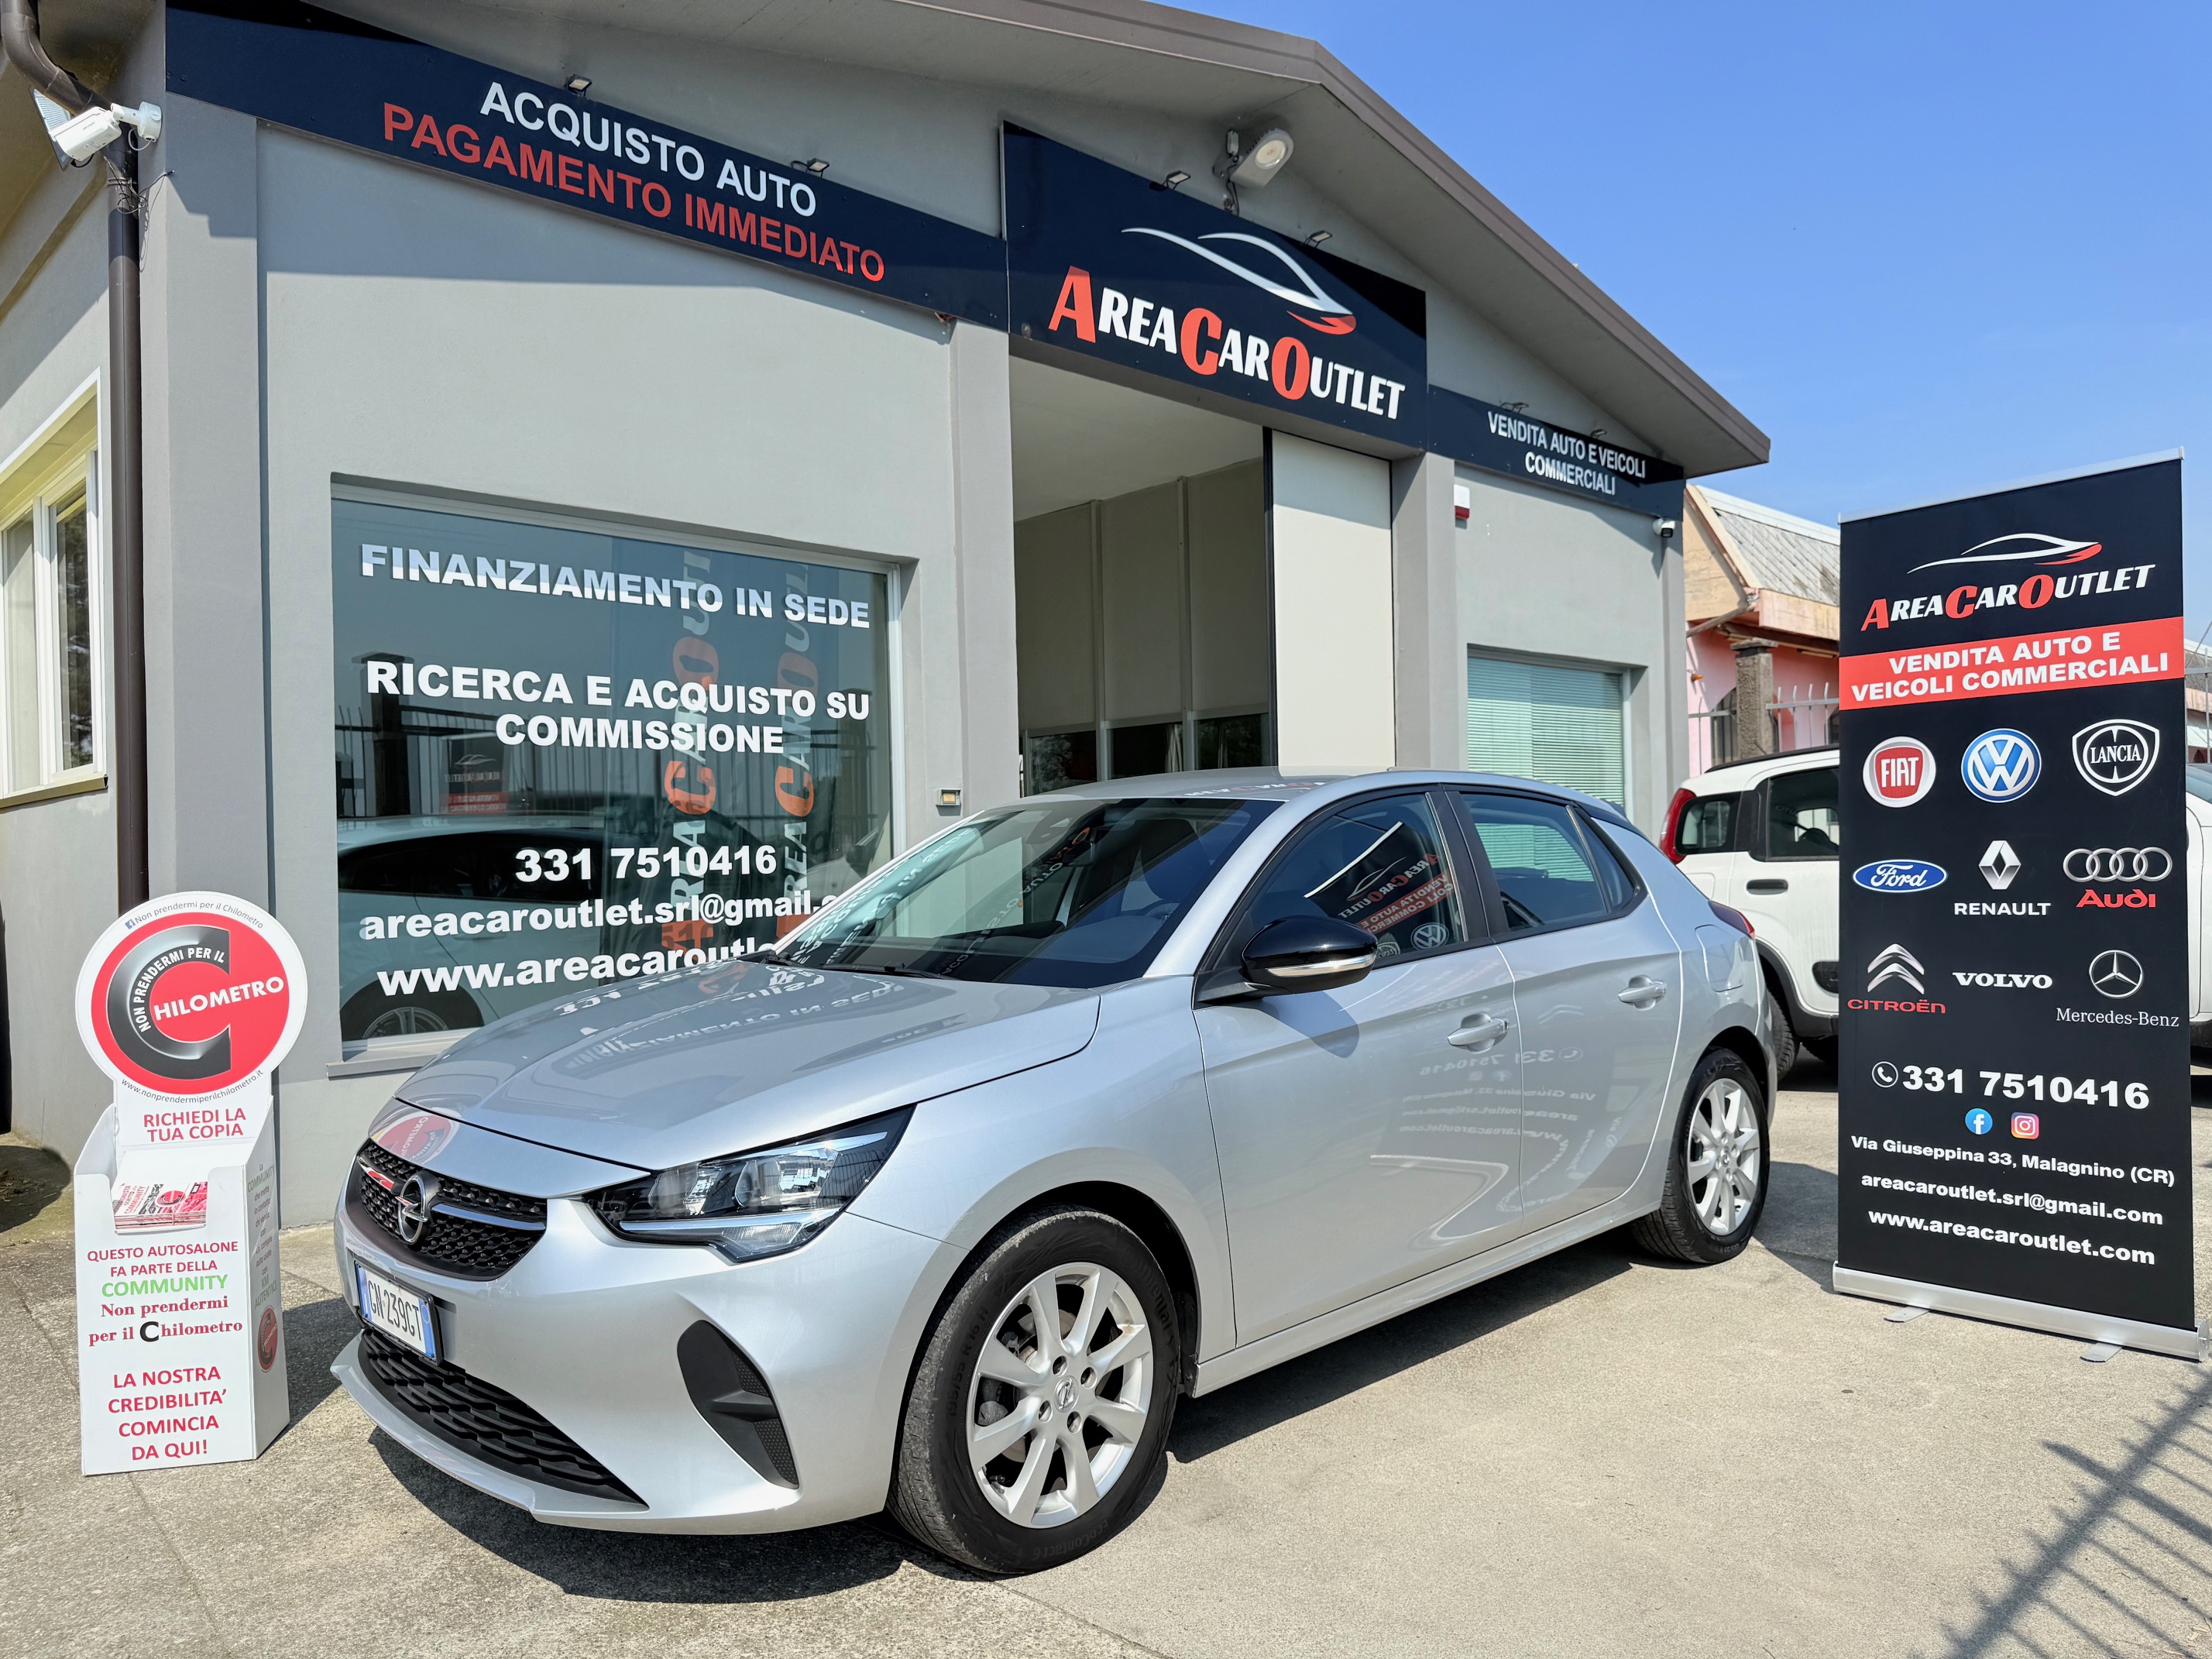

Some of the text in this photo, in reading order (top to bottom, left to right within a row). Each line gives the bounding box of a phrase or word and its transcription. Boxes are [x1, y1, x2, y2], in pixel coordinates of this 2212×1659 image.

[480, 82, 816, 217] ACQUISTO AUTO
[383, 102, 885, 282] PAGAMENTO IMMEDIATO
[1488, 411, 1646, 479] VENDITA AUTO E VEICOLI
[1525, 452, 1615, 496] COMMERCIALI
[361, 544, 870, 629] FINANZIAMENTO IN SEDE
[1889, 631, 2121, 675] VENDITA AUTO E
[366, 661, 870, 720] RICERCA E ACQUISTO SU
[1851, 652, 2168, 702] VEICOLI COMMERCIALI
[496, 713, 784, 754] COMMISSIONE
[2090, 744, 2142, 764] LANCIA
[1881, 757, 1918, 788] FIAT
[515, 845, 777, 882] 331 7510416
[1870, 864, 1927, 888] Ford
[135, 901, 263, 929] Non prendermi per il Chilometro
[1953, 902, 2051, 916] RENAULT
[132, 947, 225, 1032] NON PRENDERMI PER IL
[1953, 972, 2052, 988] VOLVO
[2056, 1008, 2179, 1027] Mercedes-Benz
[122, 1070, 263, 1104] www.nonprendermiperilchilometro.it
[1902, 1065, 2149, 1109] 331 7510416
[143, 1108, 246, 1128] RICHIEDI LA
[147, 1123, 244, 1142] TUA COPIA
[1851, 1135, 2175, 1187] Via Giuseppina 33, Malagnino (CR)
[247, 1165, 275, 1193] COMMUNITY
[1861, 1173, 2163, 1224] areacaroutlet.srl@gmail.com
[87, 1242, 238, 1262] QUESTO AUTOSALONE
[1868, 1211, 2155, 1266] www.areacaroutlet.com
[110, 1260, 218, 1277] FA PARTE DELLA
[101, 1274, 228, 1297] COMMUNITY
[101, 1295, 228, 1318] Non prendermi
[88, 1321, 242, 1346] per il Chilometro
[113, 1366, 221, 1389] LA NOSTRA
[108, 1389, 227, 1413] CREDIBILITA'
[118, 1415, 219, 1437] COMINCIA
[132, 1439, 208, 1460] DA QUI!
